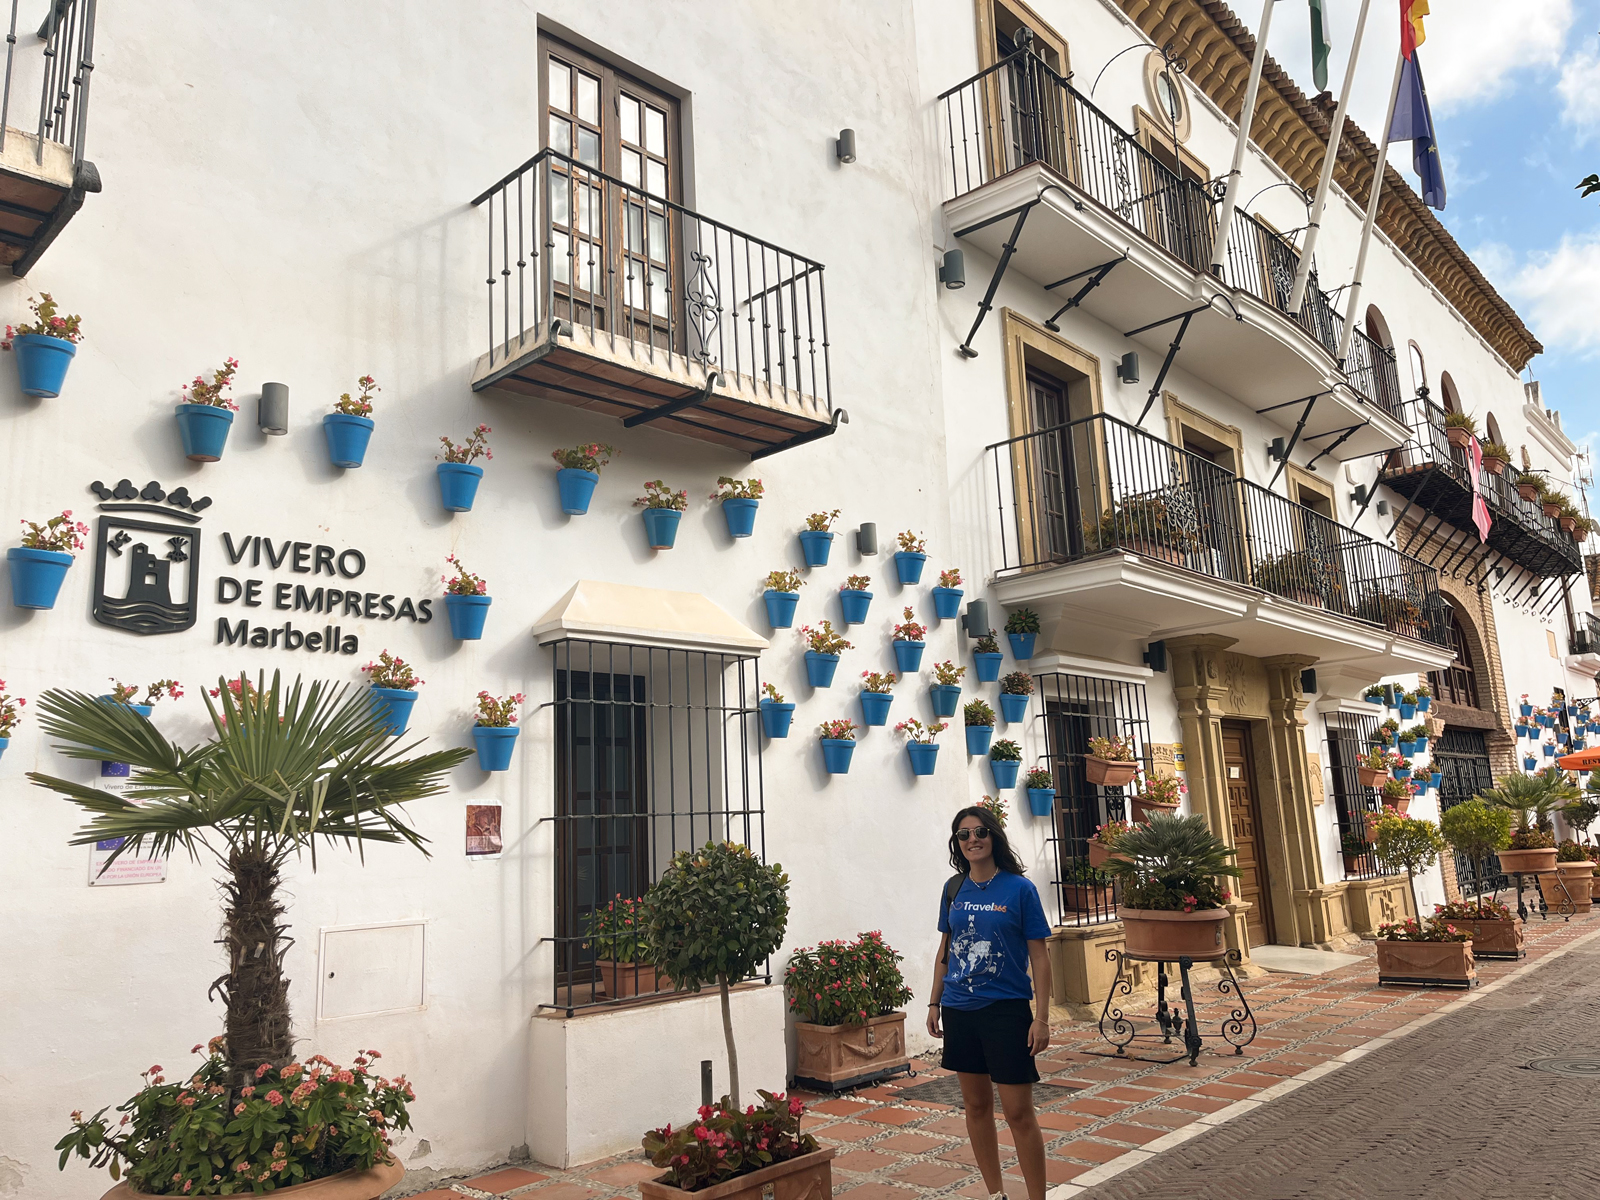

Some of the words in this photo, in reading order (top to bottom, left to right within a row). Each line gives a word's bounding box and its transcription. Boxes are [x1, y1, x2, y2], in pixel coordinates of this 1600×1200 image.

[222, 532, 366, 579] VIVERO
[216, 576, 263, 607] DE
[275, 582, 433, 624] EMPRESAS
[216, 617, 359, 655] Marbella
[963, 901, 1007, 913] Travel365
